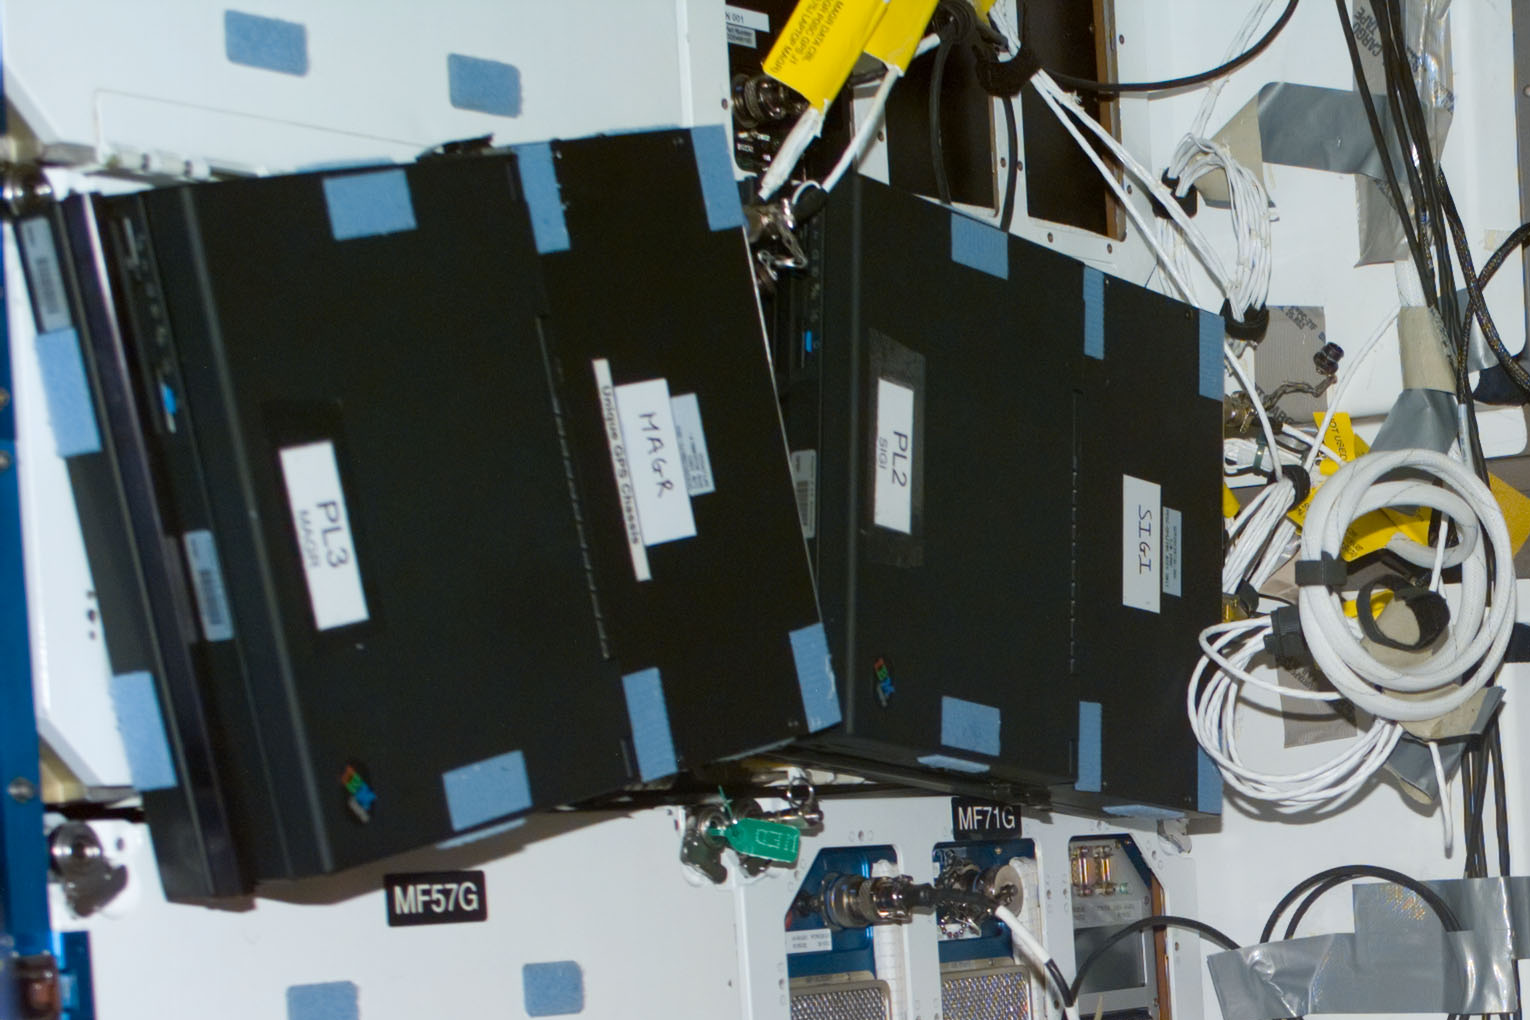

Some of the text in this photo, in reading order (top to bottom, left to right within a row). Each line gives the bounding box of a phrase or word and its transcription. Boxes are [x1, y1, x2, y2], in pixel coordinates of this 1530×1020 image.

[601, 384, 640, 545] Unique GPS Chassis
[639, 412, 675, 499] MAGR
[892, 430, 909, 488] PL2
[316, 499, 351, 569] PL3
[1138, 505, 1152, 575] SIGI
[957, 804, 1017, 832] MF71G
[394, 881, 480, 915] MF57G
